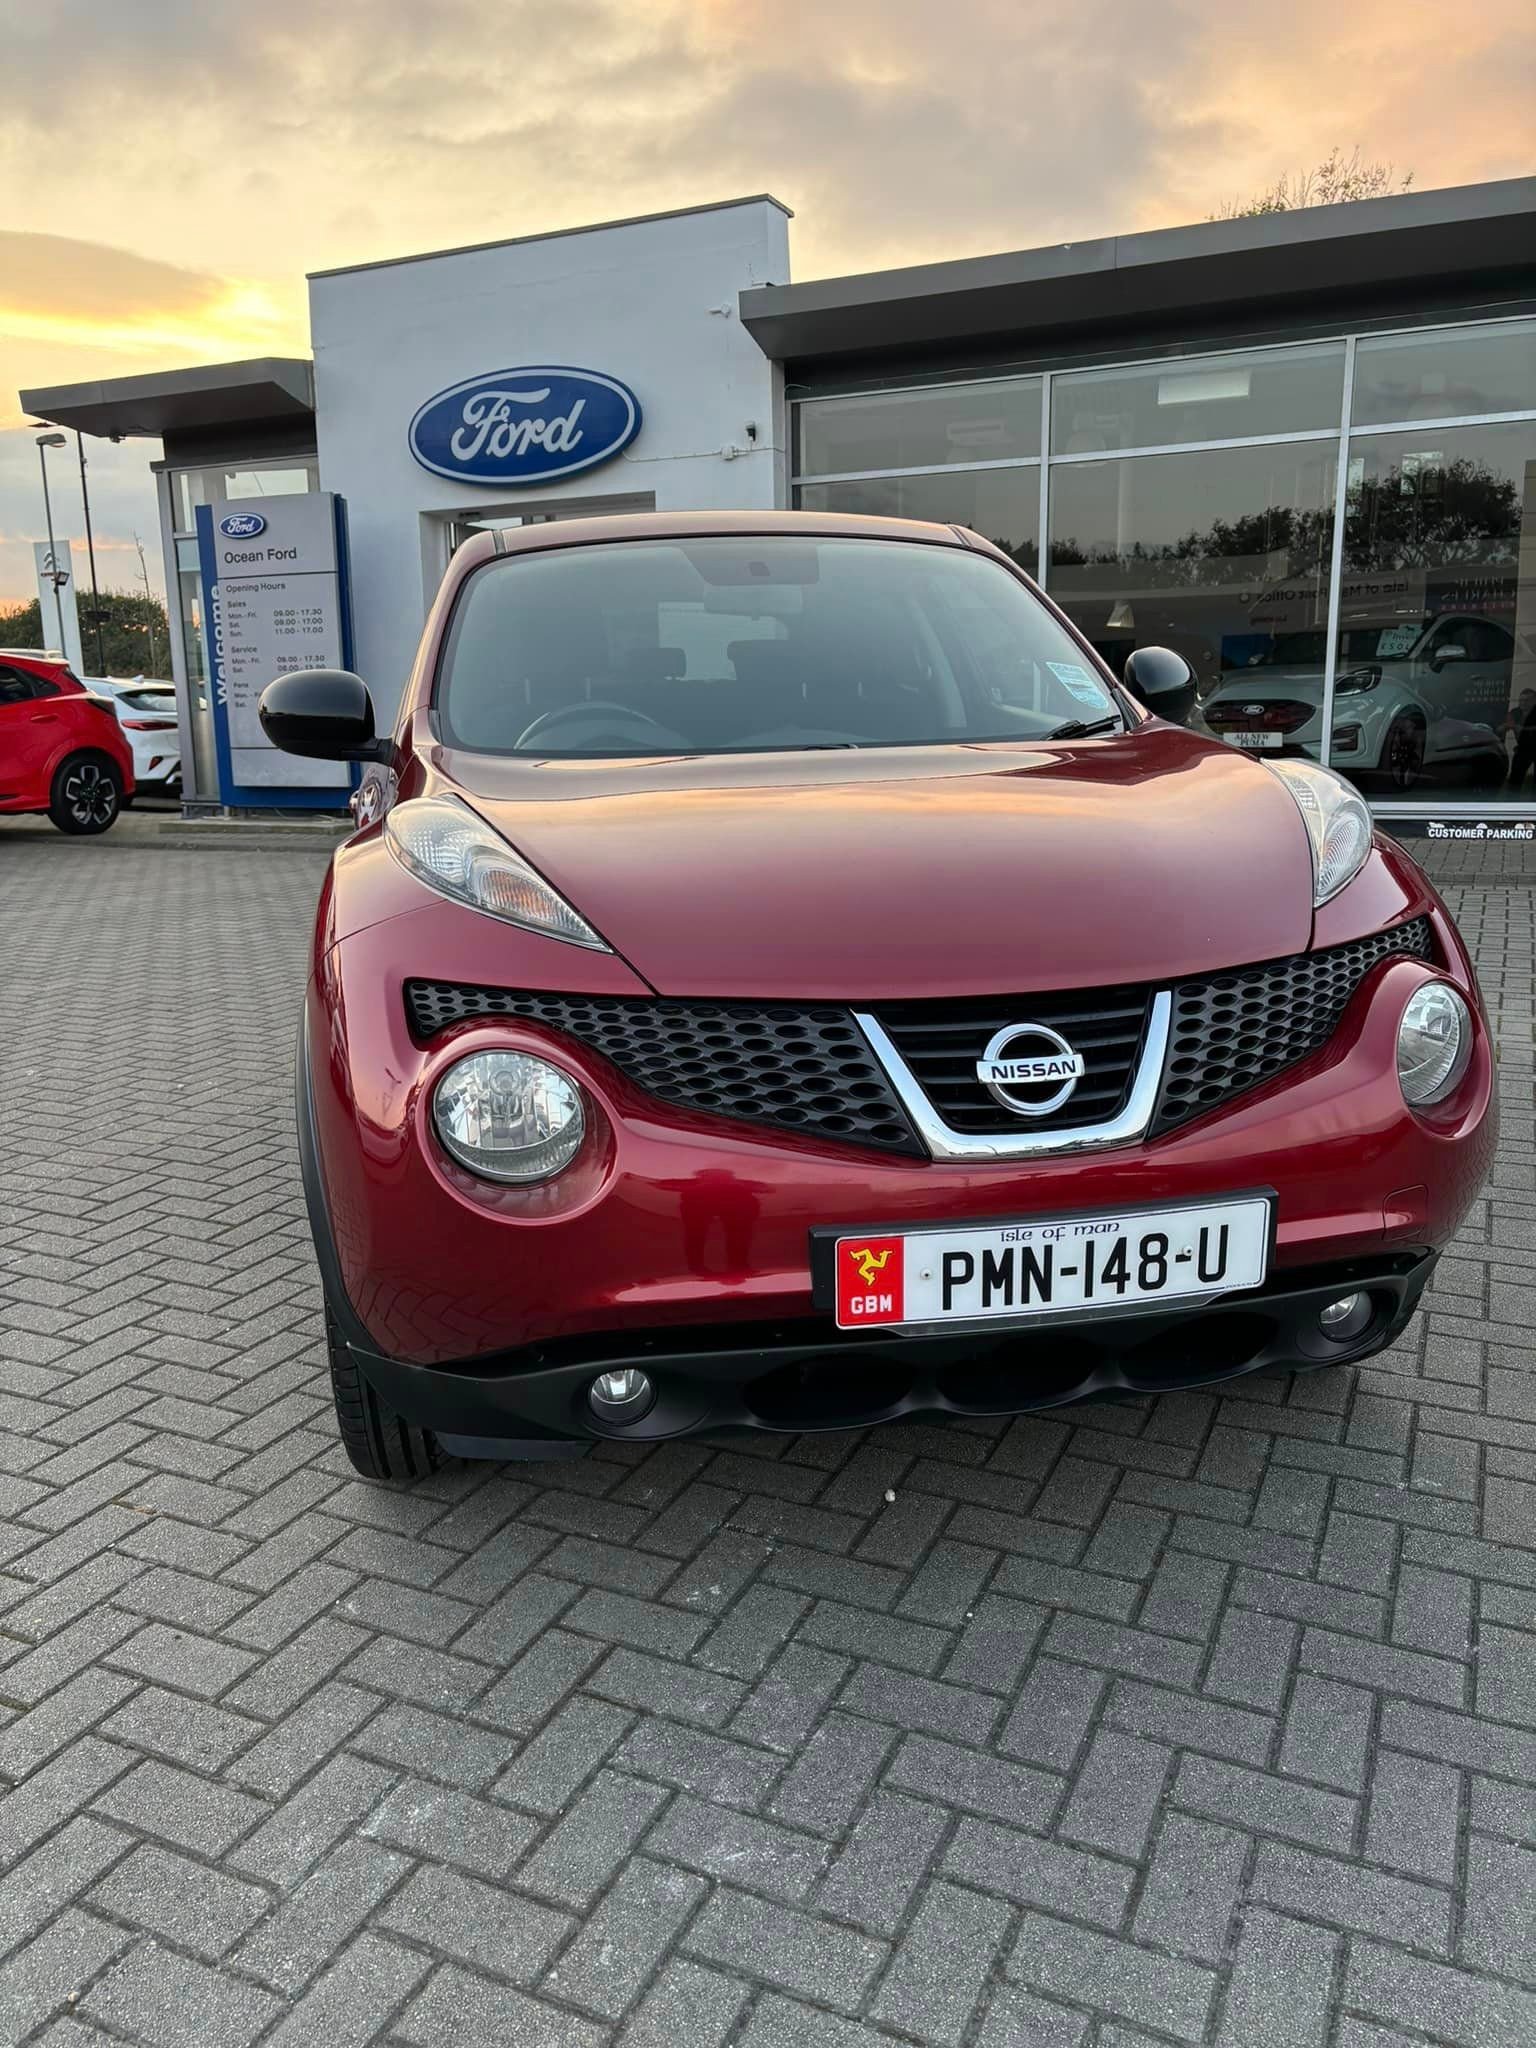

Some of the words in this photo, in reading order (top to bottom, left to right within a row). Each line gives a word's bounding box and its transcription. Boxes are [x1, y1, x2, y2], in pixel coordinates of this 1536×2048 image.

[451, 387, 586, 461] Ford
[226, 516, 256, 534] Ford
[224, 551, 264, 564] Ocean
[267, 547, 297, 560] Ford
[226, 583, 259, 594] Opening
[260, 582, 286, 591] Hours
[227, 601, 246, 609] Sales
[302, 617, 324, 625] 17.00
[302, 626, 324, 634] 17.00
[231, 645, 258, 654] Service
[1428, 828, 1484, 838] CUSTOMER
[1486, 829, 1533, 839] PARKING
[991, 1059, 1077, 1080] NISSAN
[1000, 1228, 1033, 1242] isle
[1041, 1226, 1066, 1241] of
[1073, 1222, 1120, 1236] man
[942, 1224, 1230, 1311] PMN-148-U
[851, 1294, 893, 1315] GBM
